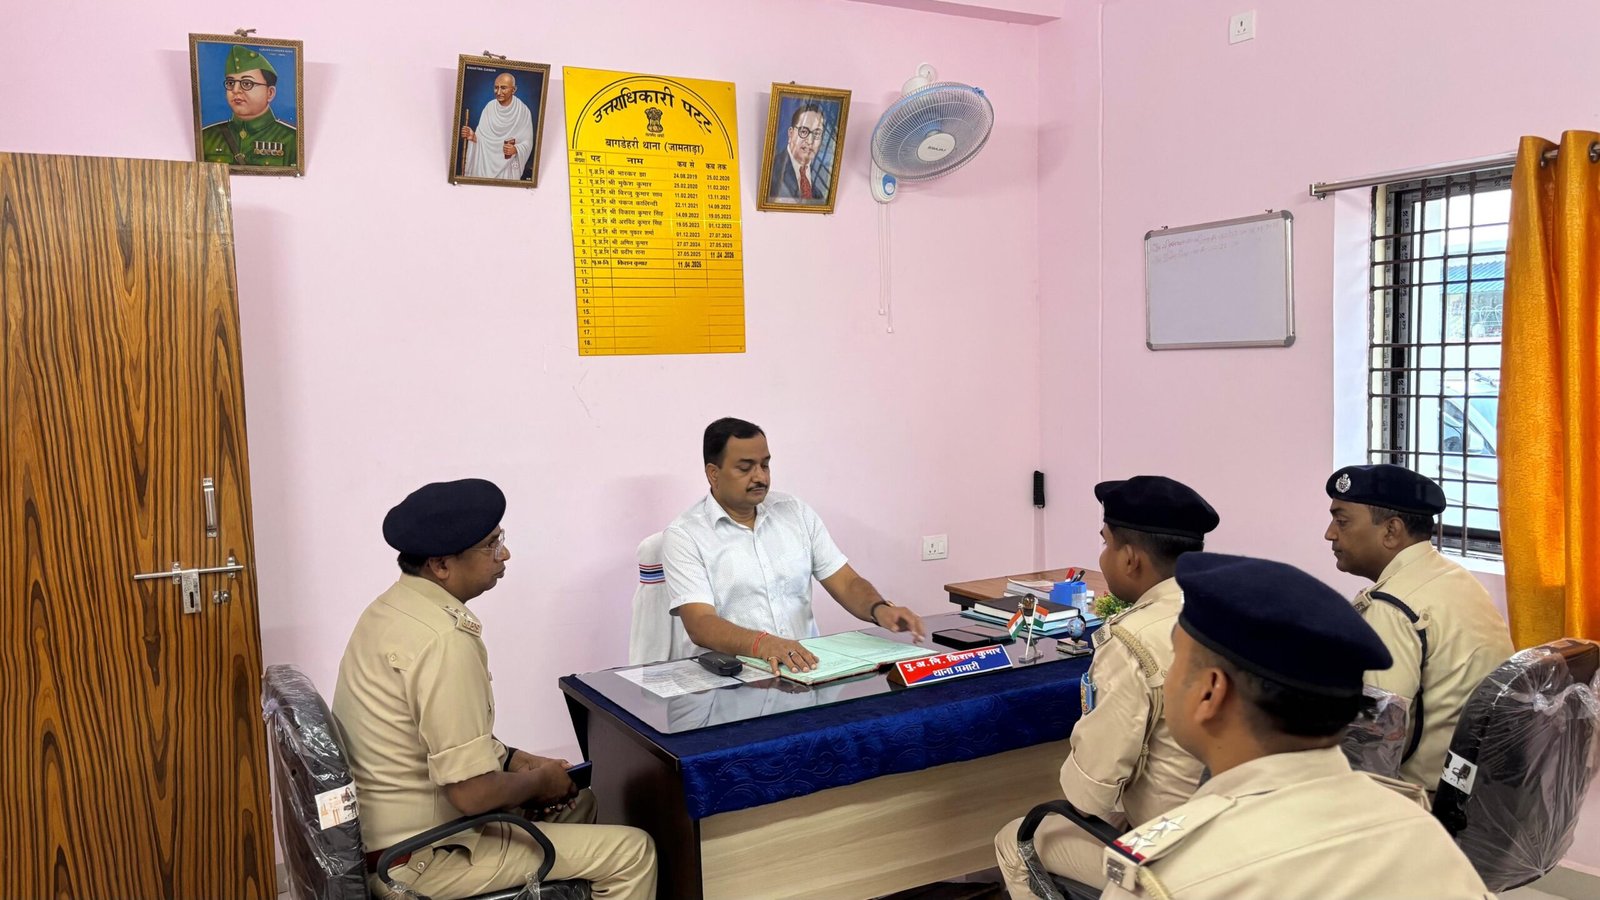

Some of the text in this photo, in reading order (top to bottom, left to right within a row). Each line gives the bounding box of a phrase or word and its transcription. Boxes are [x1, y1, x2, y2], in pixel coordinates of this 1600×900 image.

[593, 86, 675, 123] उत्तराधिकारी
[643, 141, 660, 150] थाना
[664, 142, 704, 155] (जामताड़ा)
[636, 181, 652, 189] कुमार
[977, 647, 1001, 659] कुमार
[932, 661, 980, 677] थाना प्रभारी
